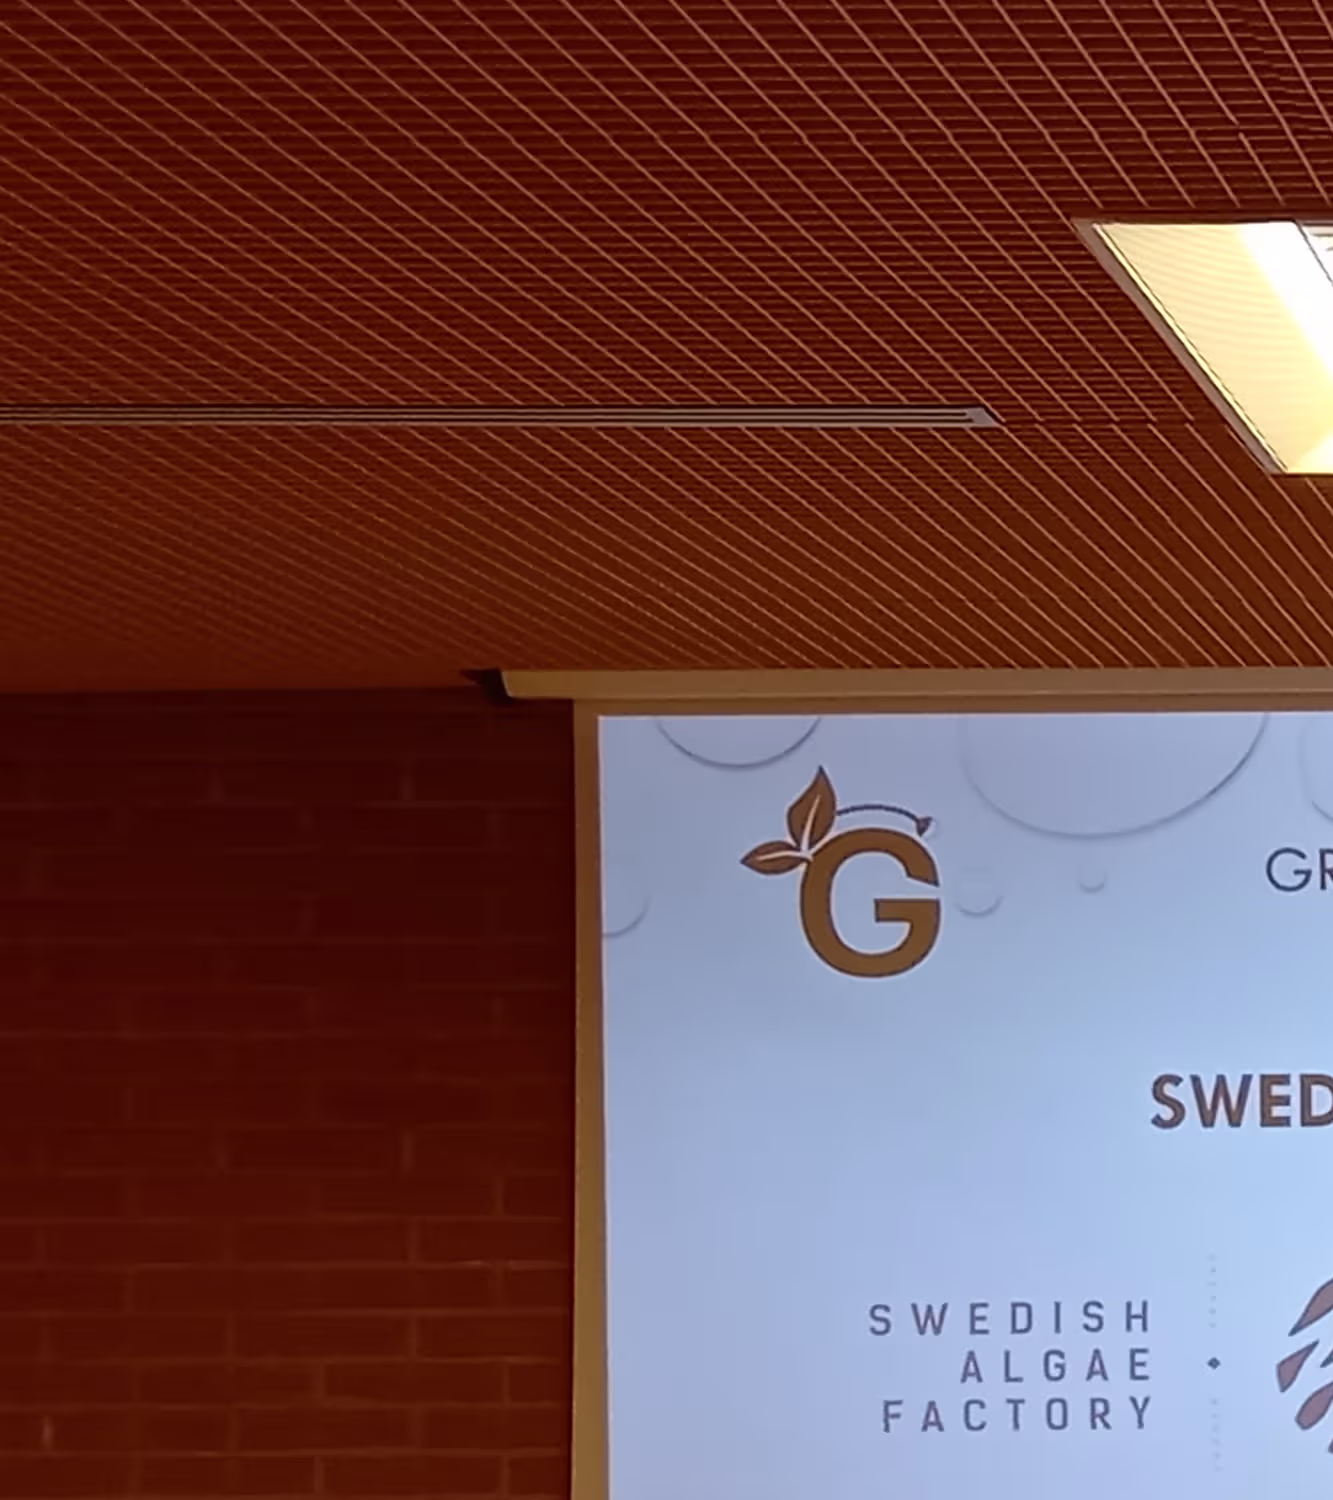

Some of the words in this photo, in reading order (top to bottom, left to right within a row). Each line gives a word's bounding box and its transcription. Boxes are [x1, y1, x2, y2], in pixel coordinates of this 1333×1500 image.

[799, 826, 942, 979] G
[869, 1299, 1149, 1337] SWEDISH
[960, 1347, 1150, 1384] ALGAE
[882, 1395, 1151, 1434] FACTORY
